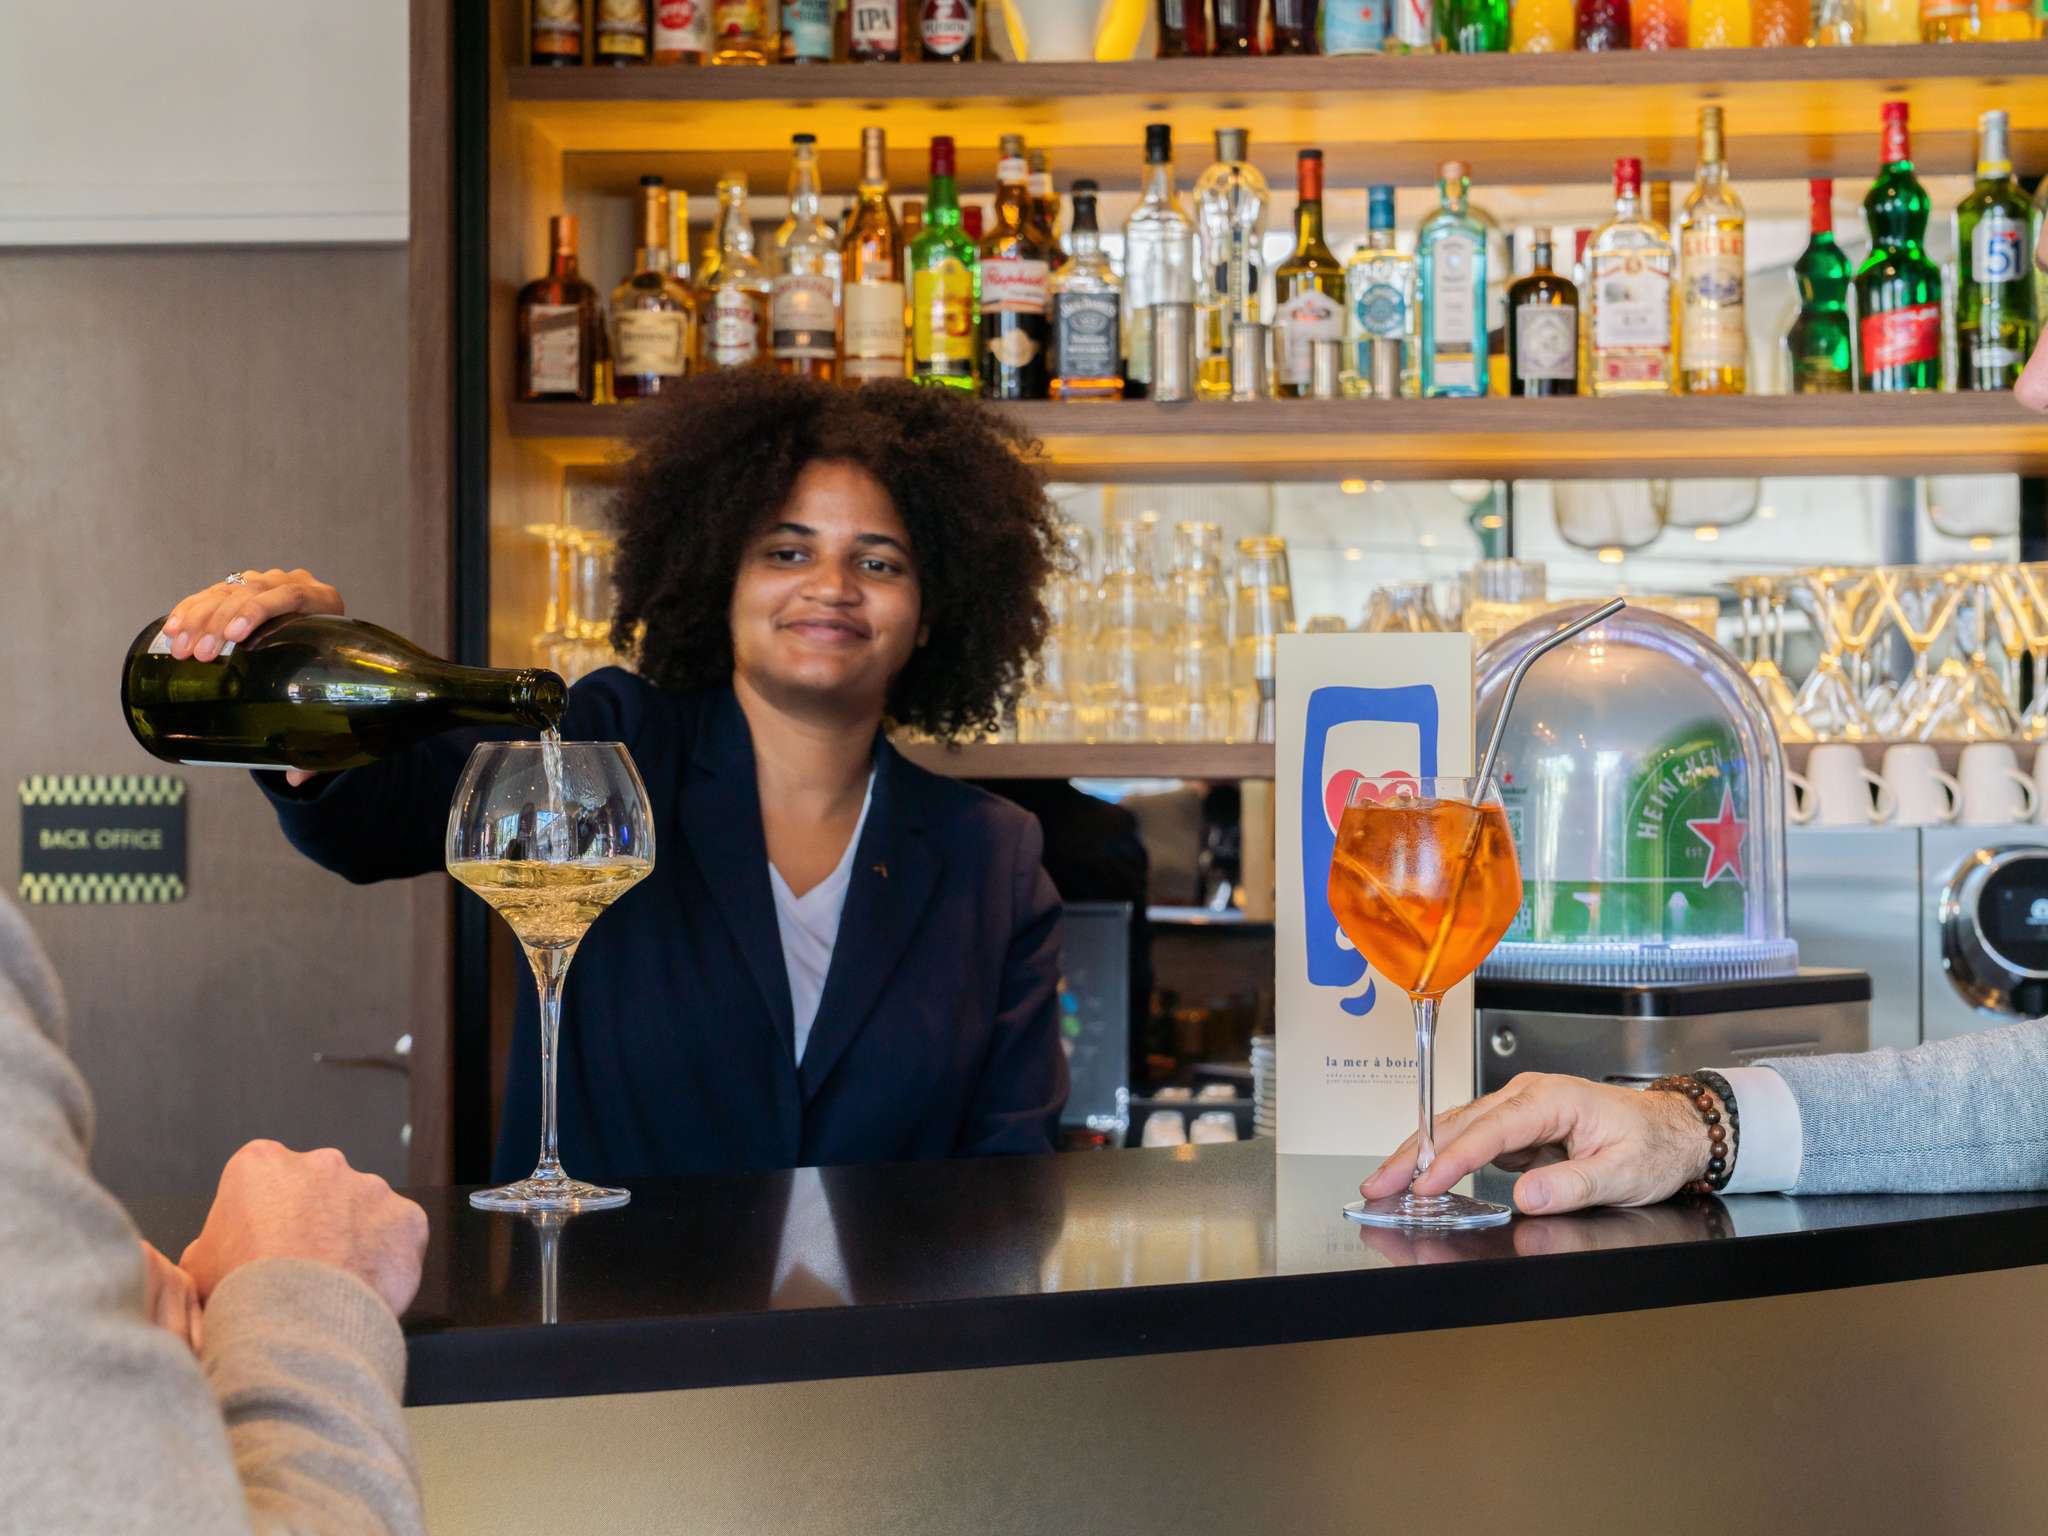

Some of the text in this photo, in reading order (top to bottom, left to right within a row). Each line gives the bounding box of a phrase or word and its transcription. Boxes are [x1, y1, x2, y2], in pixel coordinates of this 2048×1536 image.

[857, 8, 891, 32] IPA
[1987, 238, 2022, 275] 51
[1636, 747, 1723, 839] HEINEKEN
[39, 828, 163, 850] BACK OFFICE
[1325, 1055, 1338, 1067] la
[1343, 1058, 1369, 1067] mer
[1374, 1056, 1381, 1067] à
